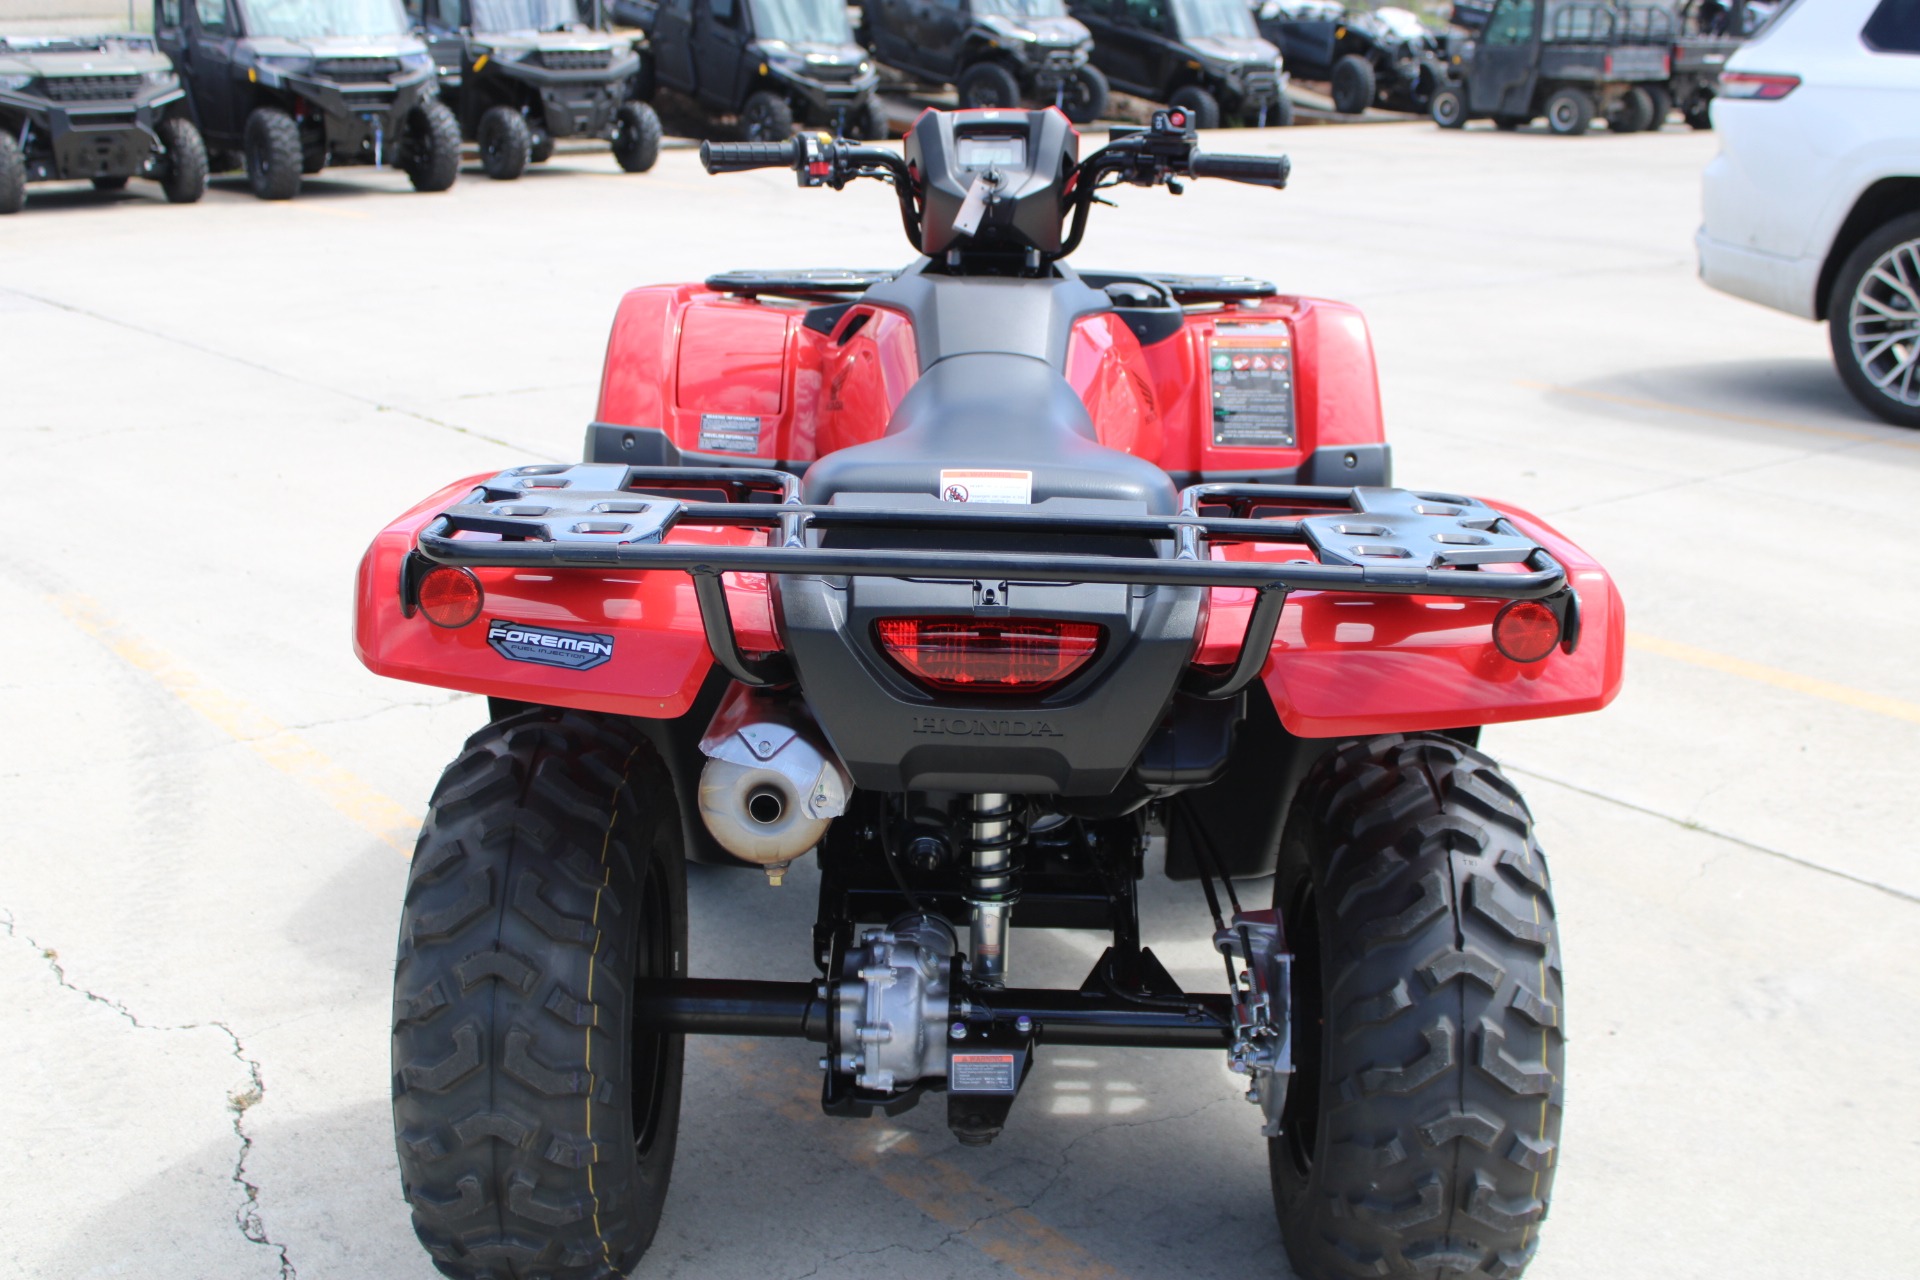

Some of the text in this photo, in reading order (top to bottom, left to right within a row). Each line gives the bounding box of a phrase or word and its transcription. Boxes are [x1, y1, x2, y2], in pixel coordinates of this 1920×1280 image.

[488, 628, 613, 656] FOREMAN
[511, 645, 586, 660] FUEL INJECTION
[912, 717, 1064, 737] HONDA
